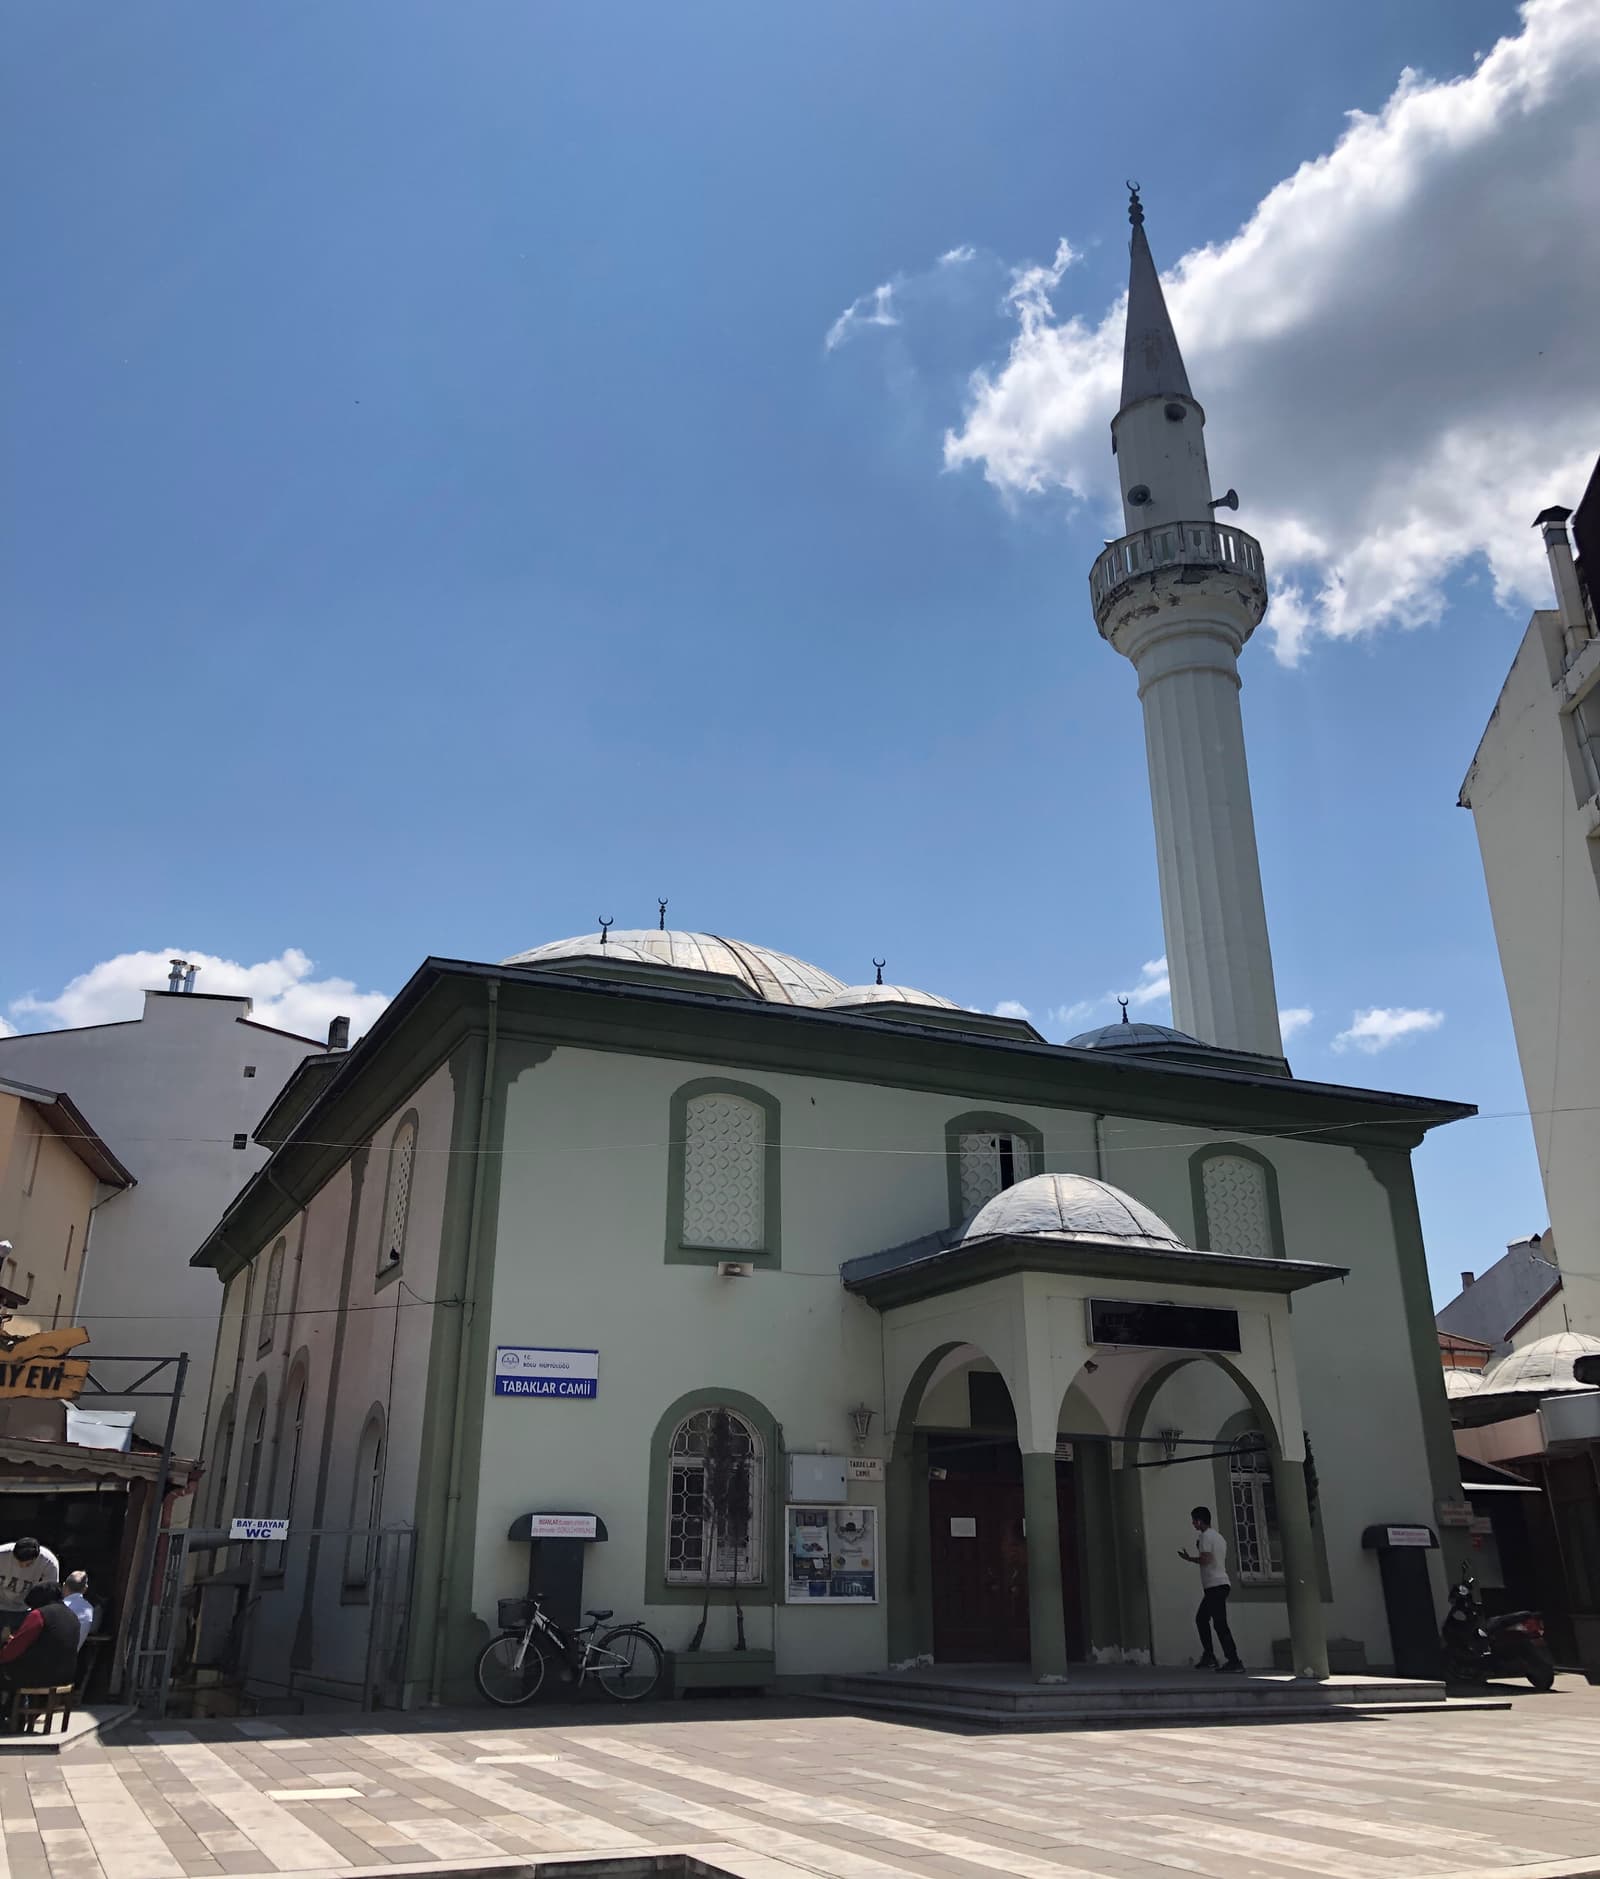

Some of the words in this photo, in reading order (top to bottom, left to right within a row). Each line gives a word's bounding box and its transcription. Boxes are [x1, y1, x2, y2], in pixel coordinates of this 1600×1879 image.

[502, 1380, 556, 1394] TABAKLAR
[559, 1380, 591, 1396] CAMİİ
[246, 1528, 271, 1538] WC
